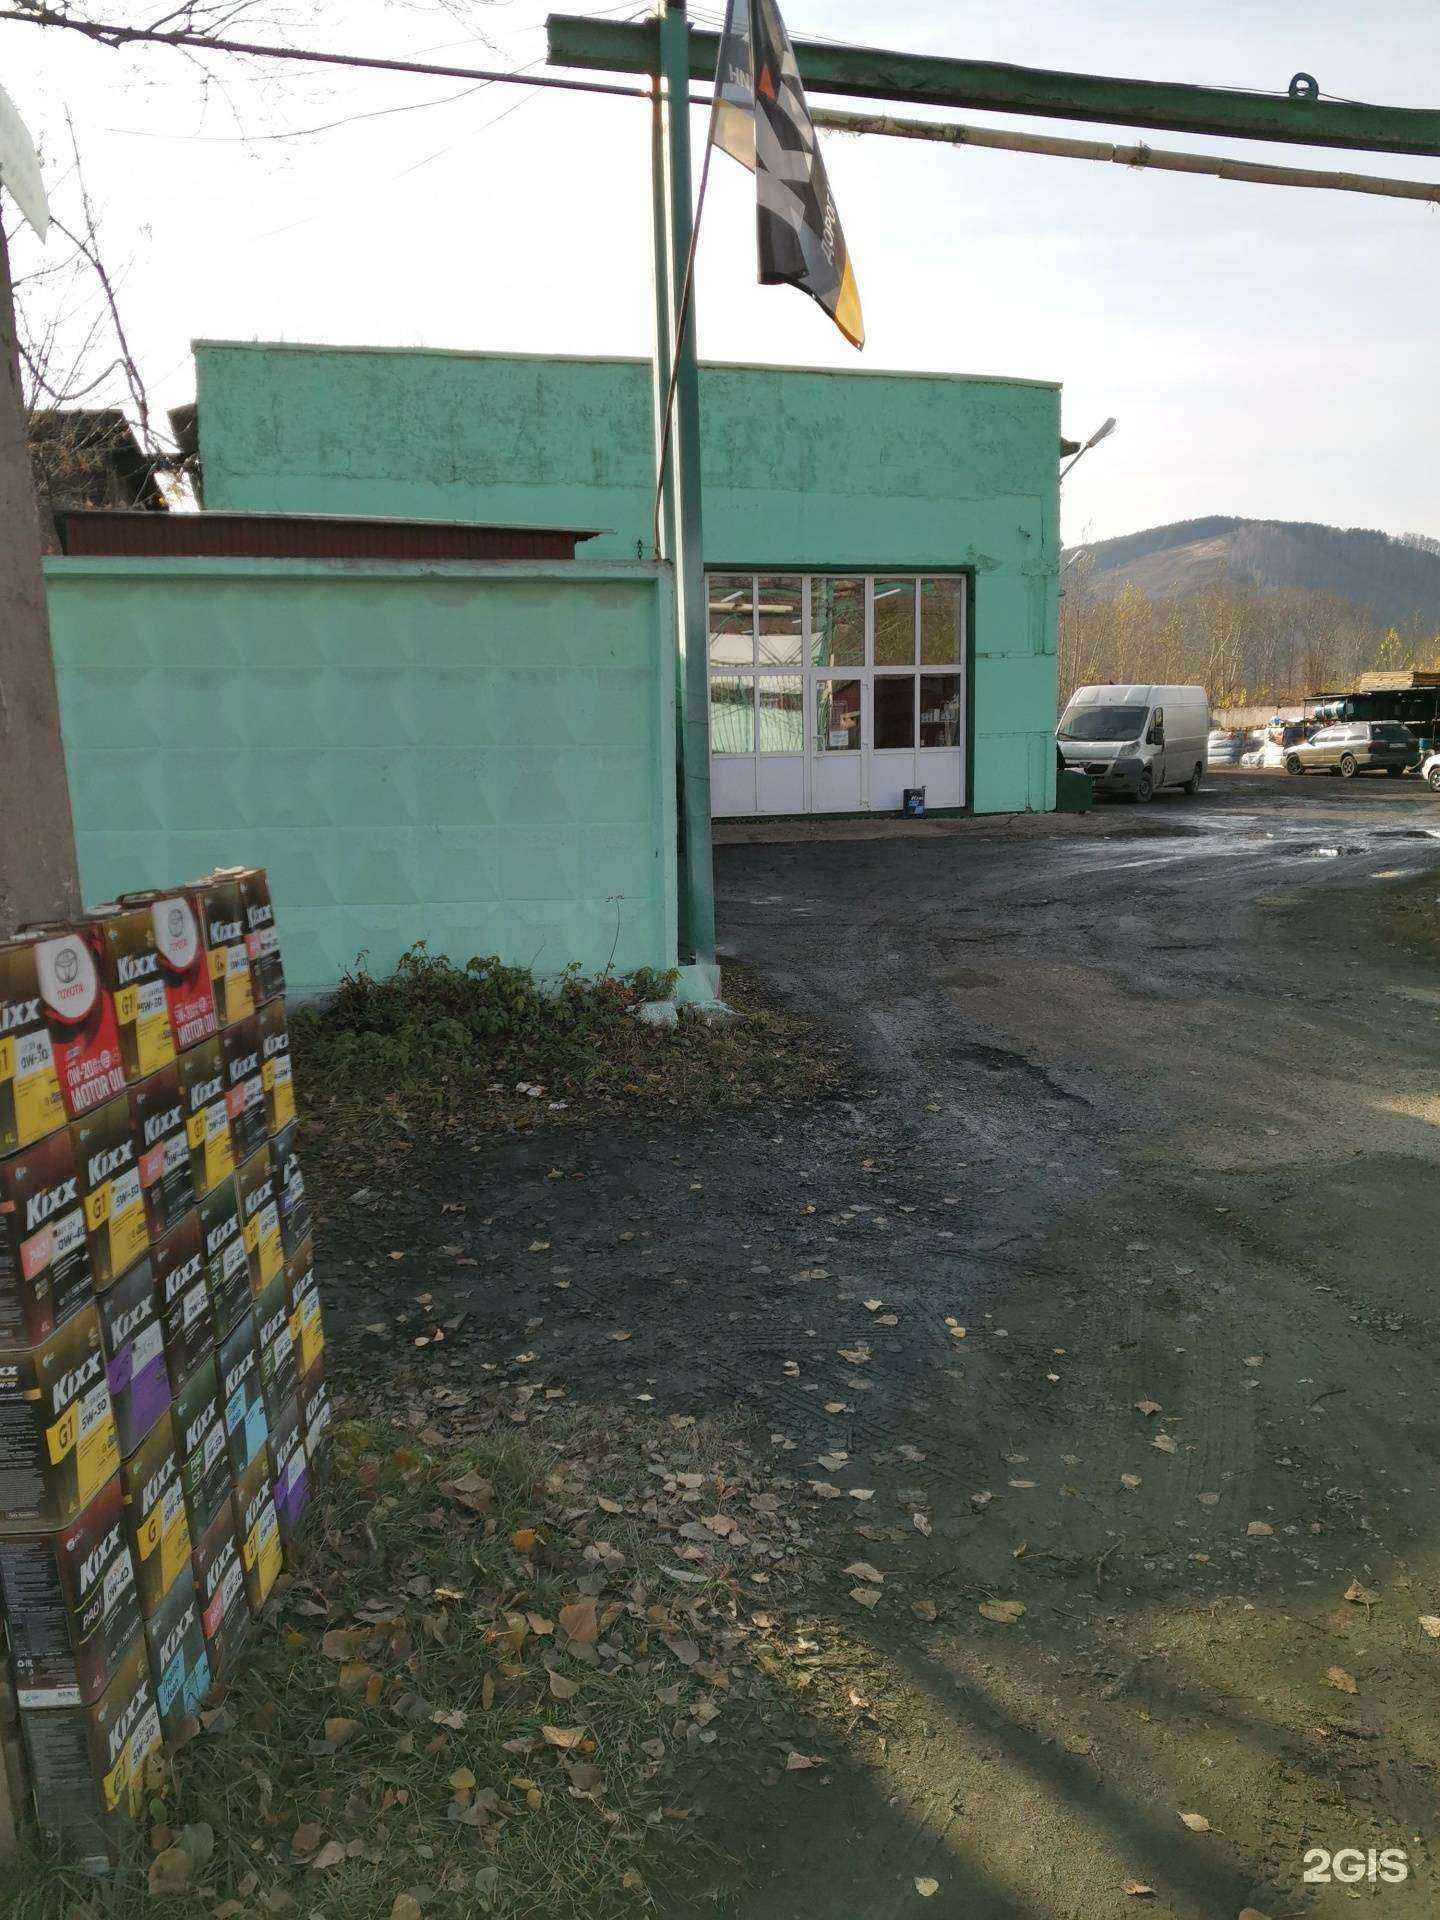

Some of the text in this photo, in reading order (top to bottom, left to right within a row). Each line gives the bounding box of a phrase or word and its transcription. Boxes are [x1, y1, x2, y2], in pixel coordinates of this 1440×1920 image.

[116, 953, 159, 984] Kixx
[0, 998, 40, 1030] ixx
[229, 1051, 258, 1083] Kixx
[71, 1075, 109, 1112] MOTOR
[190, 1075, 223, 1110] Kixx
[144, 1105, 184, 1146] Kixx
[88, 1139, 133, 1187] Kixx
[26, 1177, 78, 1232] Kixx
[245, 1179, 273, 1218] Kixx
[206, 1214, 240, 1261] Kixx
[165, 1252, 203, 1305] Kixx
[111, 1294, 154, 1352] Kixx
[260, 1304, 289, 1351] Kixx
[52, 1350, 103, 1416] Kixx
[59, 1415, 73, 1449] G1
[186, 1396, 217, 1456] Kixx
[142, 1452, 177, 1519] Kixx
[245, 1477, 272, 1534] Kixx
[80, 1521, 121, 1597] Kixx
[206, 1534, 236, 1601] Kixx
[160, 1600, 195, 1678] Kixx
[108, 1678, 150, 1768] Kixx
